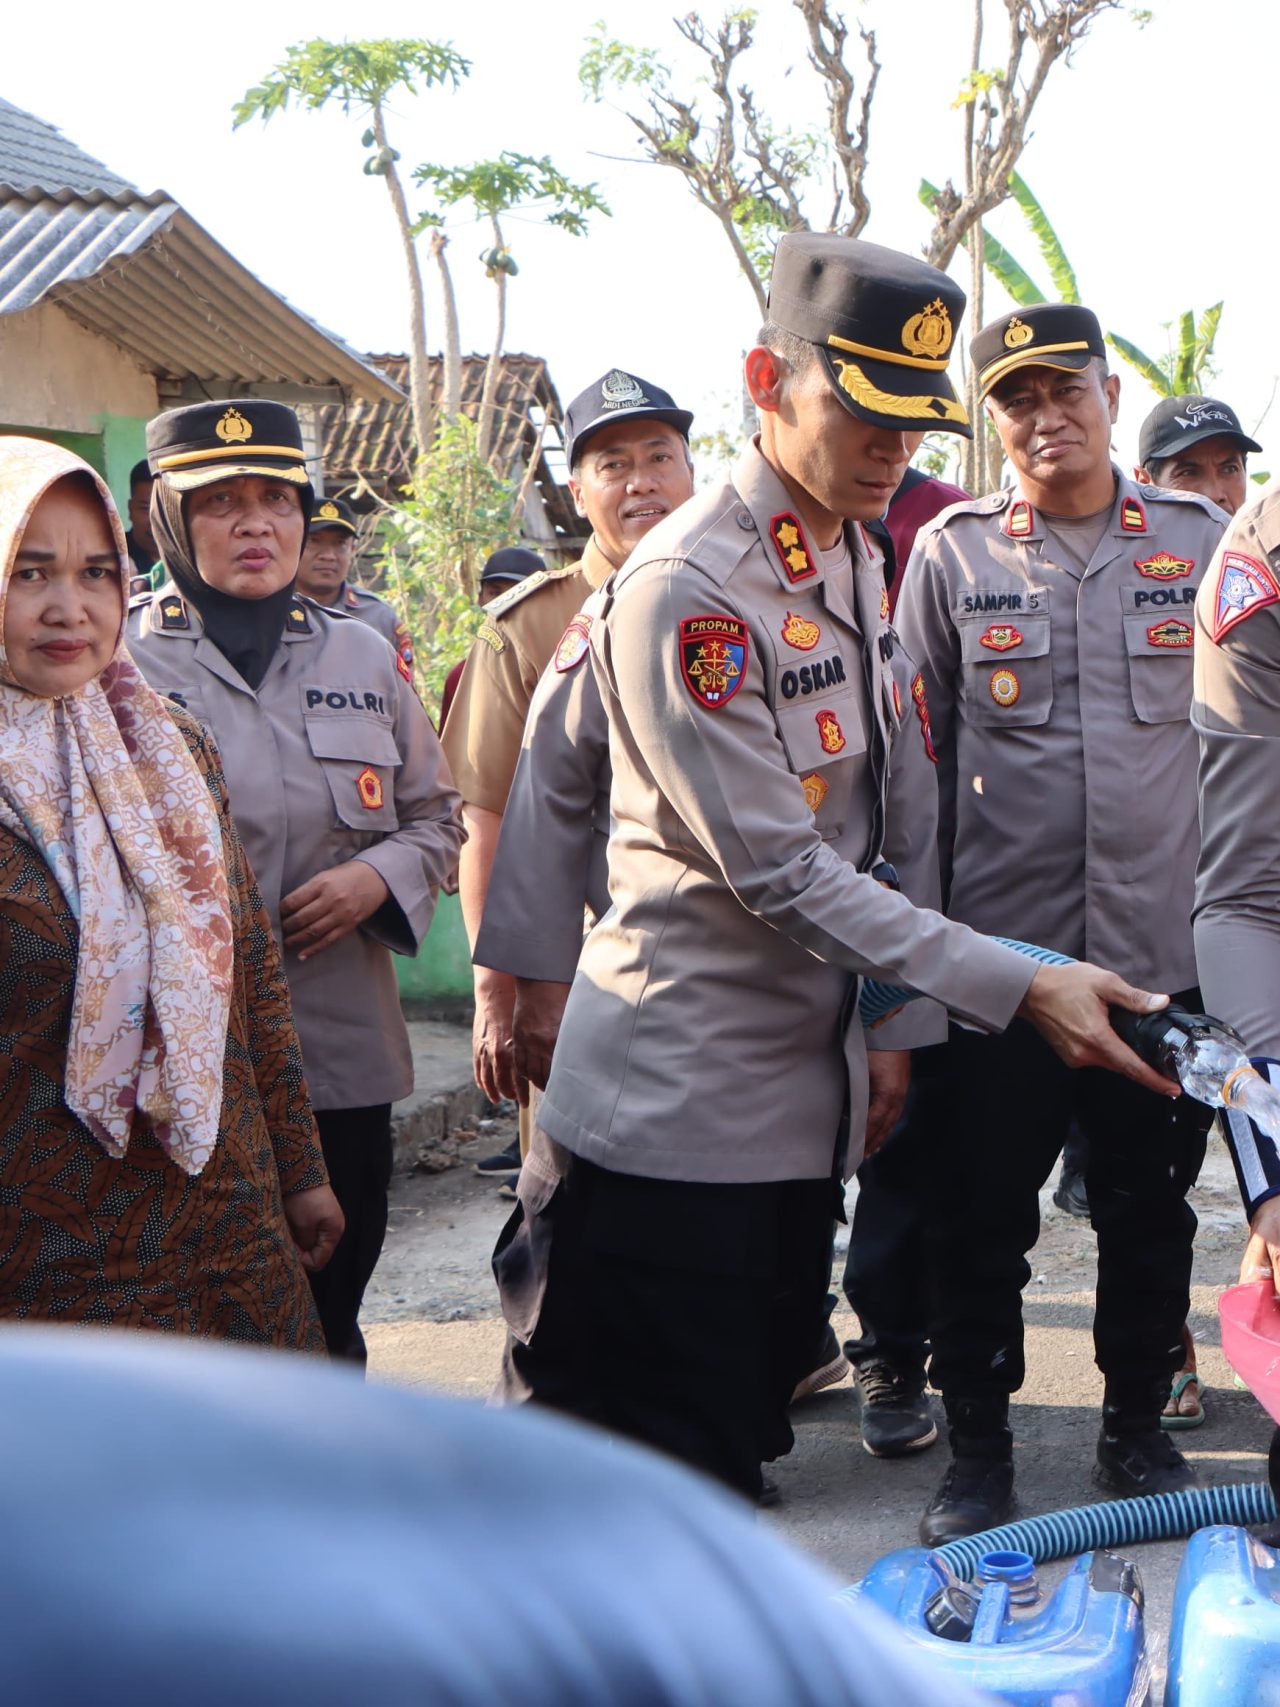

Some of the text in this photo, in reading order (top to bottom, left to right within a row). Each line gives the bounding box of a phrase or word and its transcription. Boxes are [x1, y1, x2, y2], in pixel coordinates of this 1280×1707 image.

[964, 594, 1022, 613] SAMPIR
[691, 620, 739, 634] PROPAM
[781, 655, 847, 699] OSKAR
[305, 690, 385, 715] POLRI
